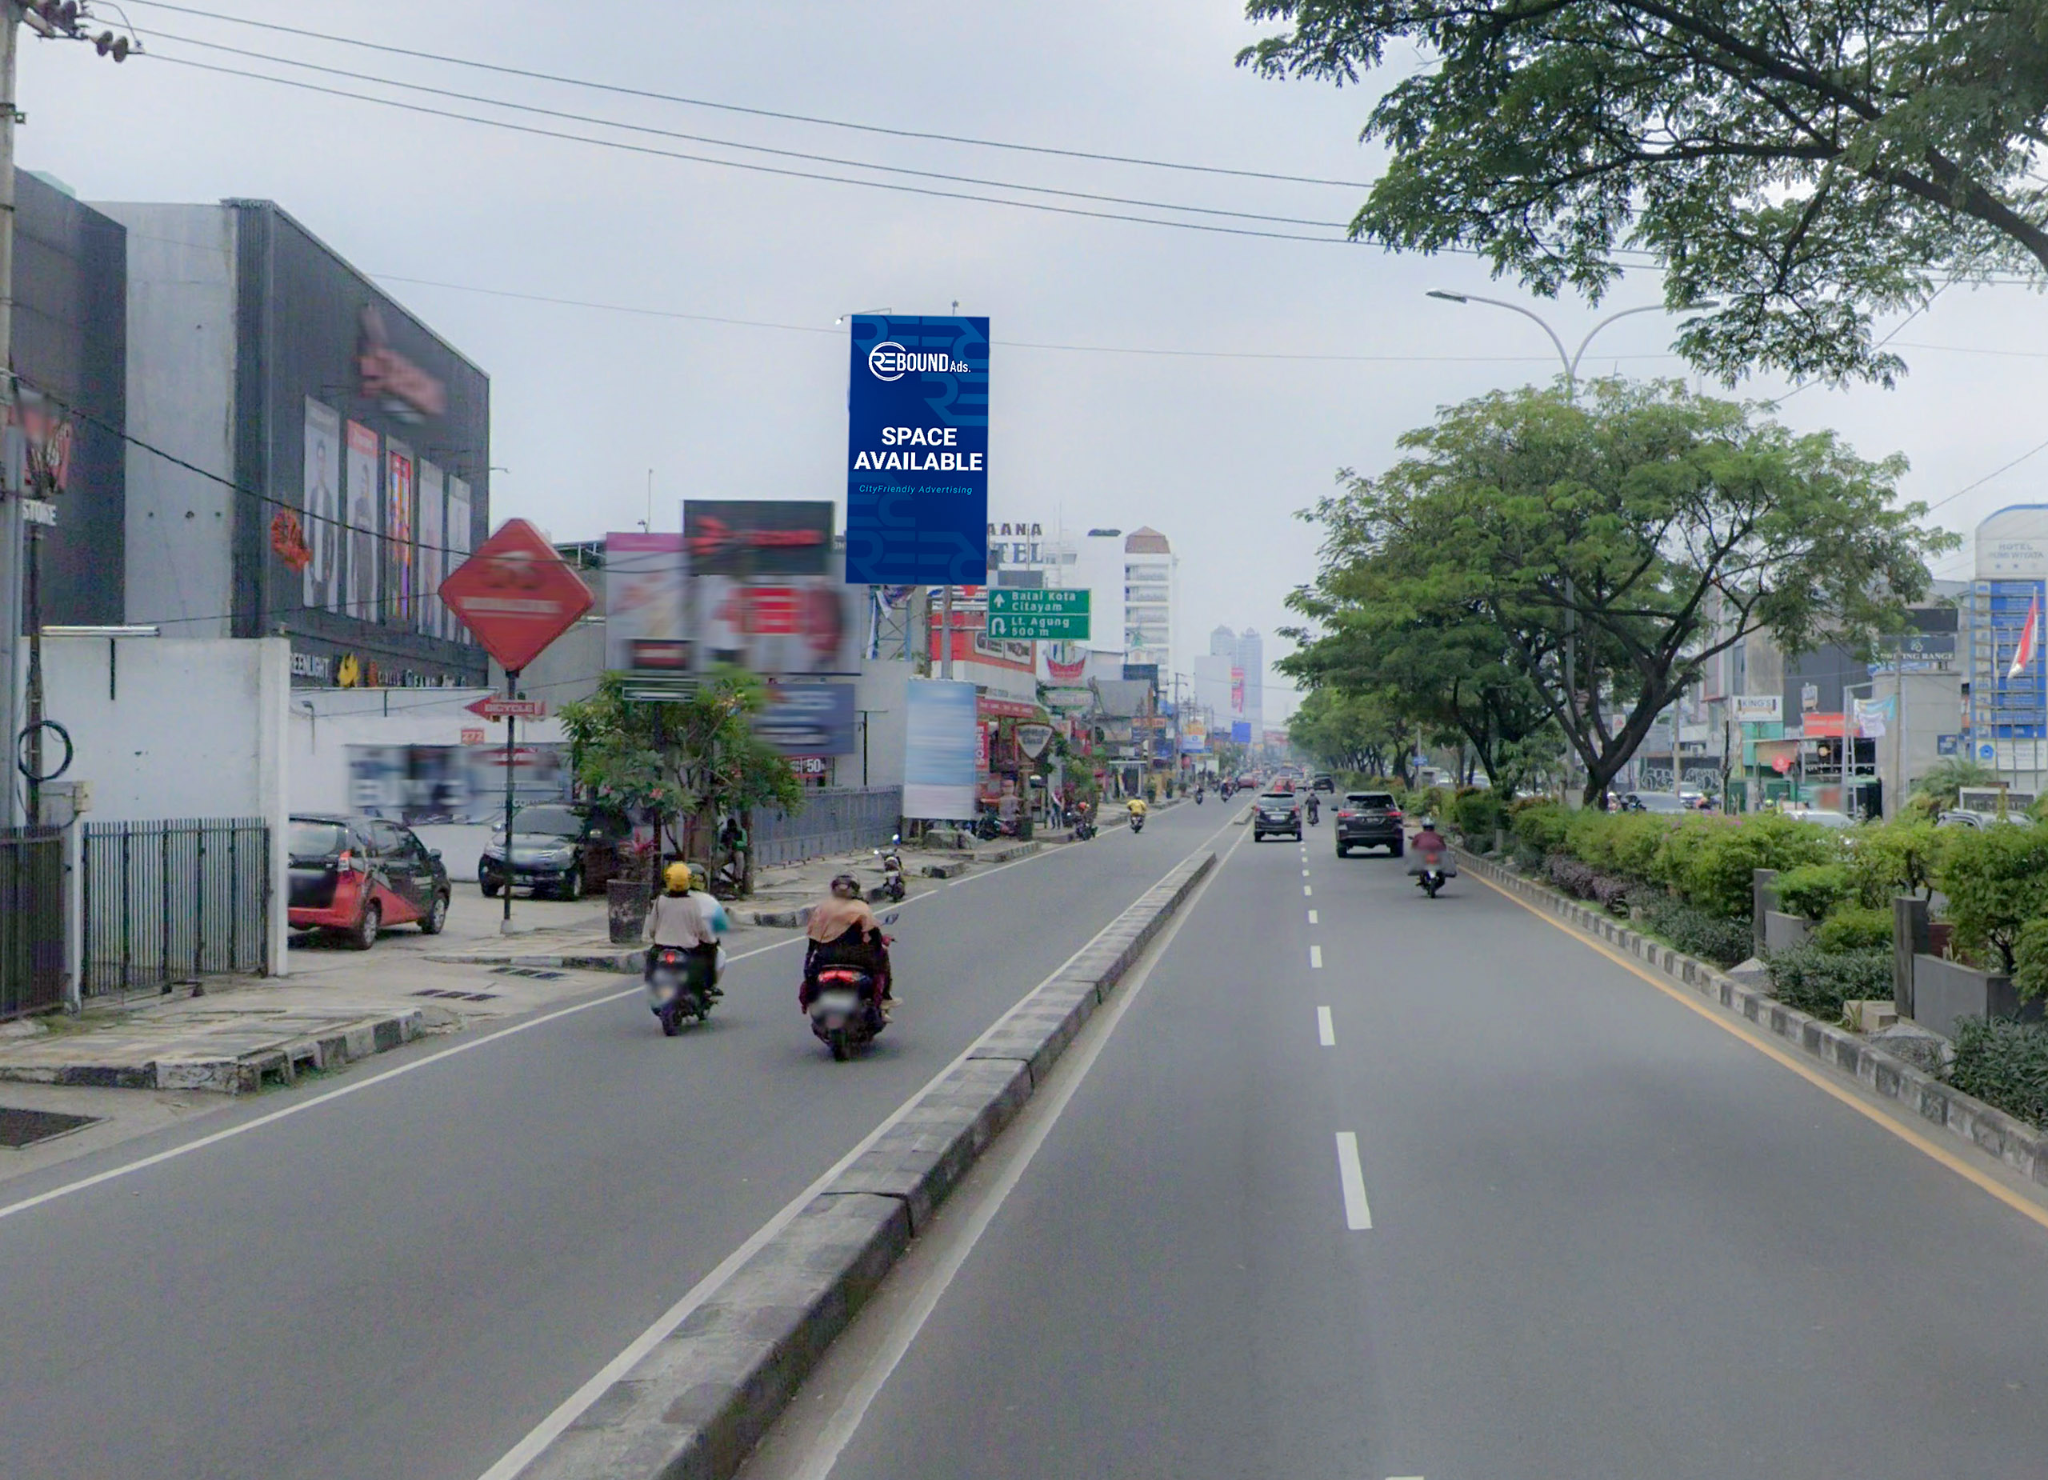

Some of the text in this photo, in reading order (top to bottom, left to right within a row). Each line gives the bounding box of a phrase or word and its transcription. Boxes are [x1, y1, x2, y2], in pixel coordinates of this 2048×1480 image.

[950, 360, 971, 373] Ads.
[881, 426, 958, 446] SPACE
[853, 451, 983, 471] AVAILABLE
[858, 484, 973, 495] CityFriendly Advertising
[1998, 543, 2033, 551] HOTEL
[1012, 591, 1076, 601] Balai Kota
[1012, 602, 1062, 613] Citayam
[1031, 617, 1070, 628] Agung
[1012, 627, 1049, 636] 500 m
[485, 703, 534, 712] BICYCLE
[975, 726, 985, 765] ENEOS
